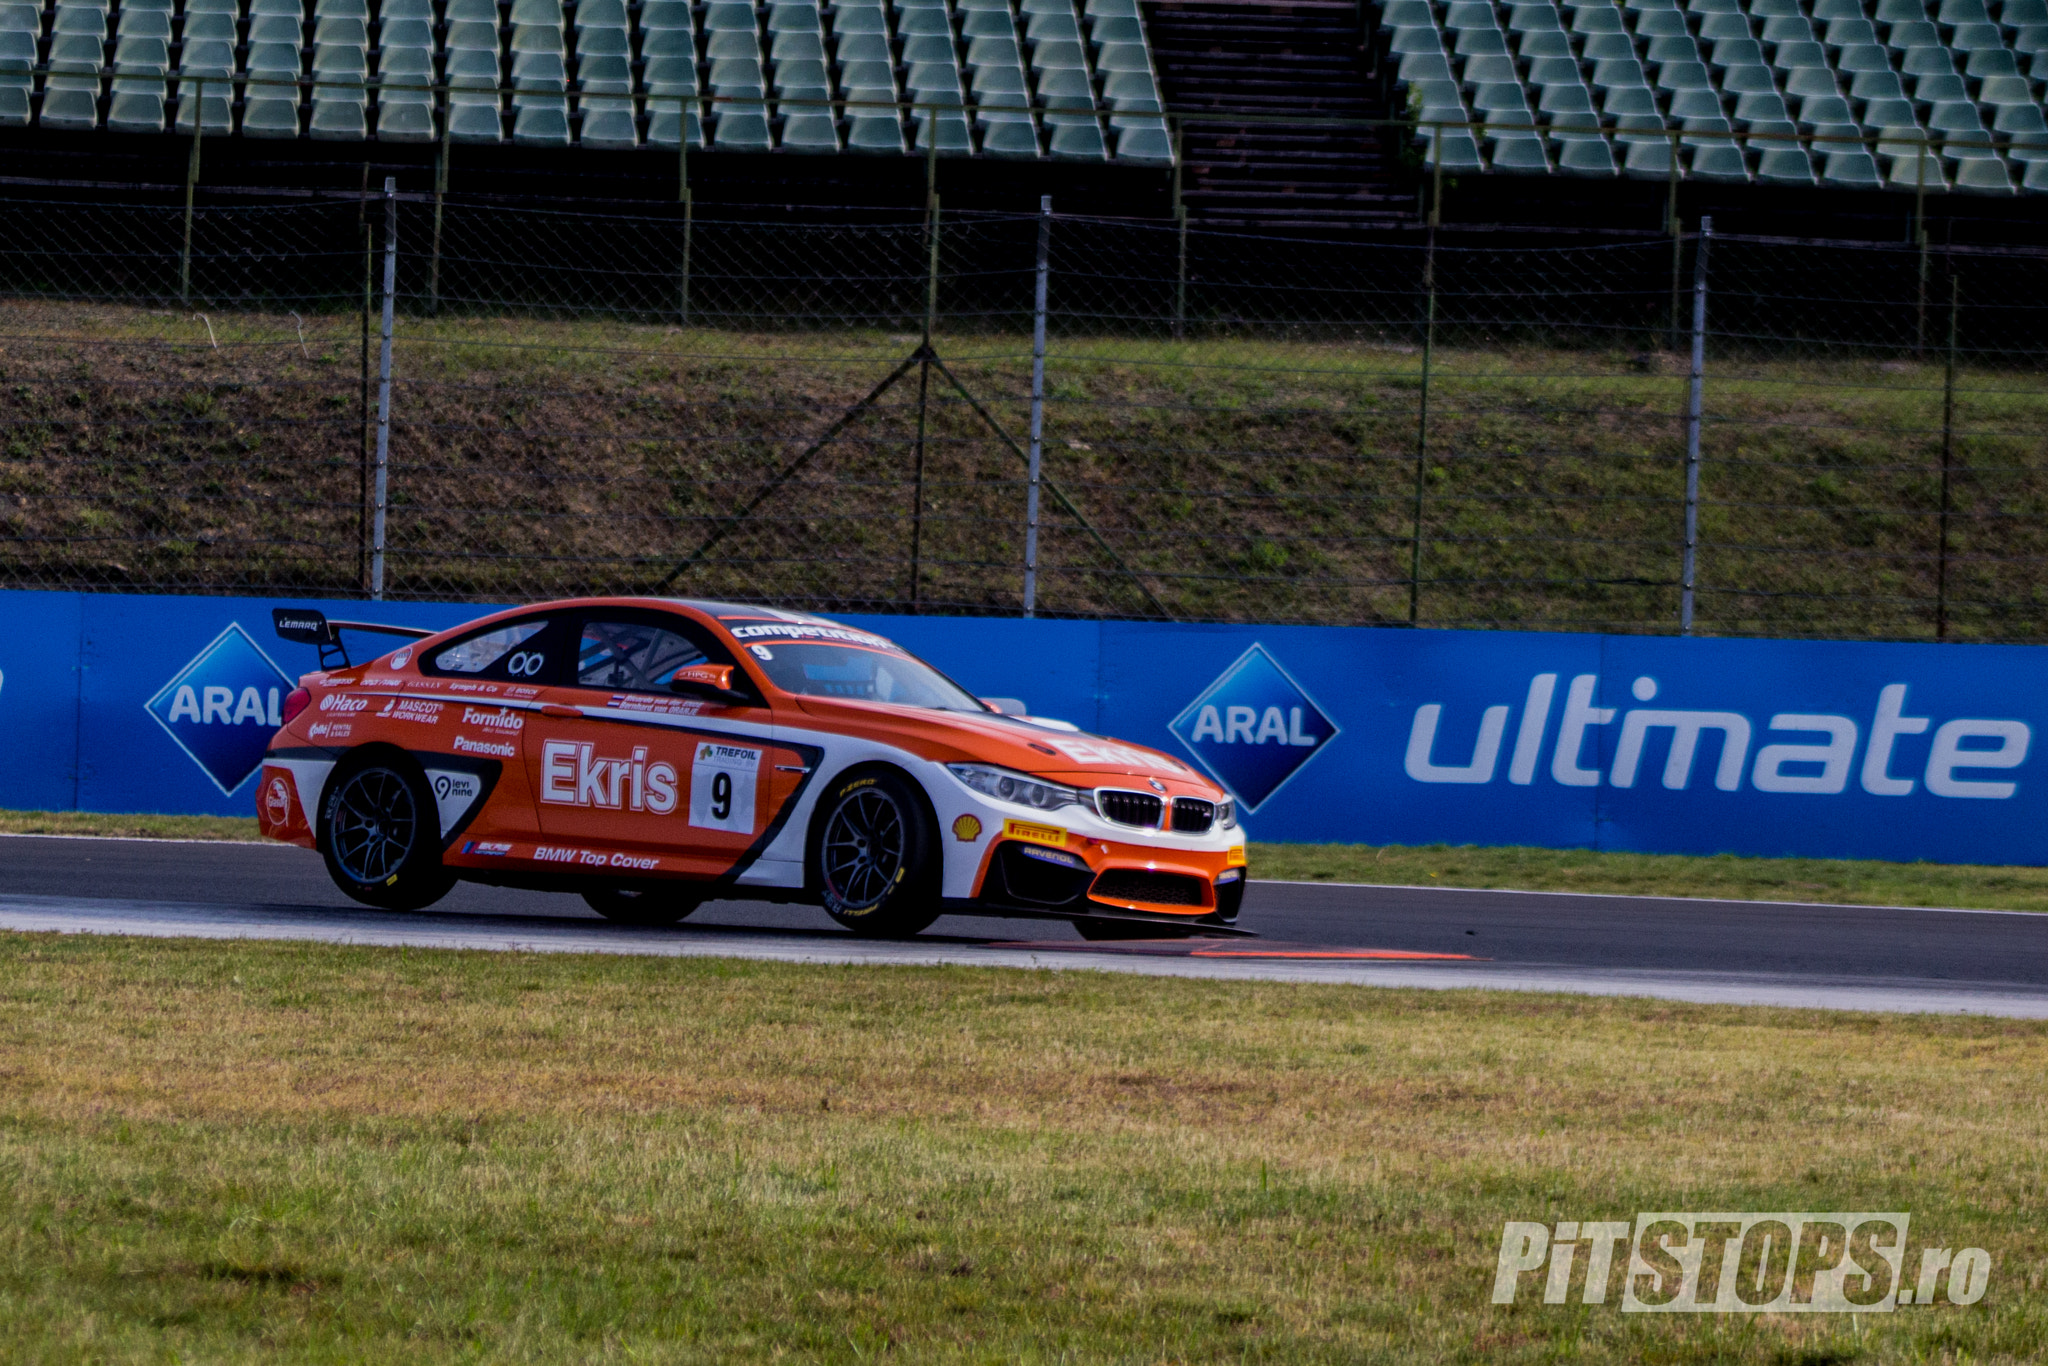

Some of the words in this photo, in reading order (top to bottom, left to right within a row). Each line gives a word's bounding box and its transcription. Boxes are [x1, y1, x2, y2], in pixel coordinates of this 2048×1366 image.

[751, 645, 773, 661] 9
[168, 685, 282, 727] ARAL
[330, 694, 368, 711] Haco
[462, 707, 523, 729] Formido
[1191, 705, 1316, 747] ARAL
[453, 735, 515, 757] Panasonic
[1404, 673, 2032, 799] ultimate
[716, 746, 756, 760] TREFOIL
[452, 780, 469, 788] levi
[541, 739, 677, 815] Ekris
[452, 788, 472, 797] nine
[711, 772, 732, 821] 9
[1009, 822, 1061, 843] PIRELLI
[533, 847, 575, 862] BMW
[579, 851, 606, 866] Top
[610, 853, 659, 870] Cover
[1023, 847, 1074, 864] RAVENOL
